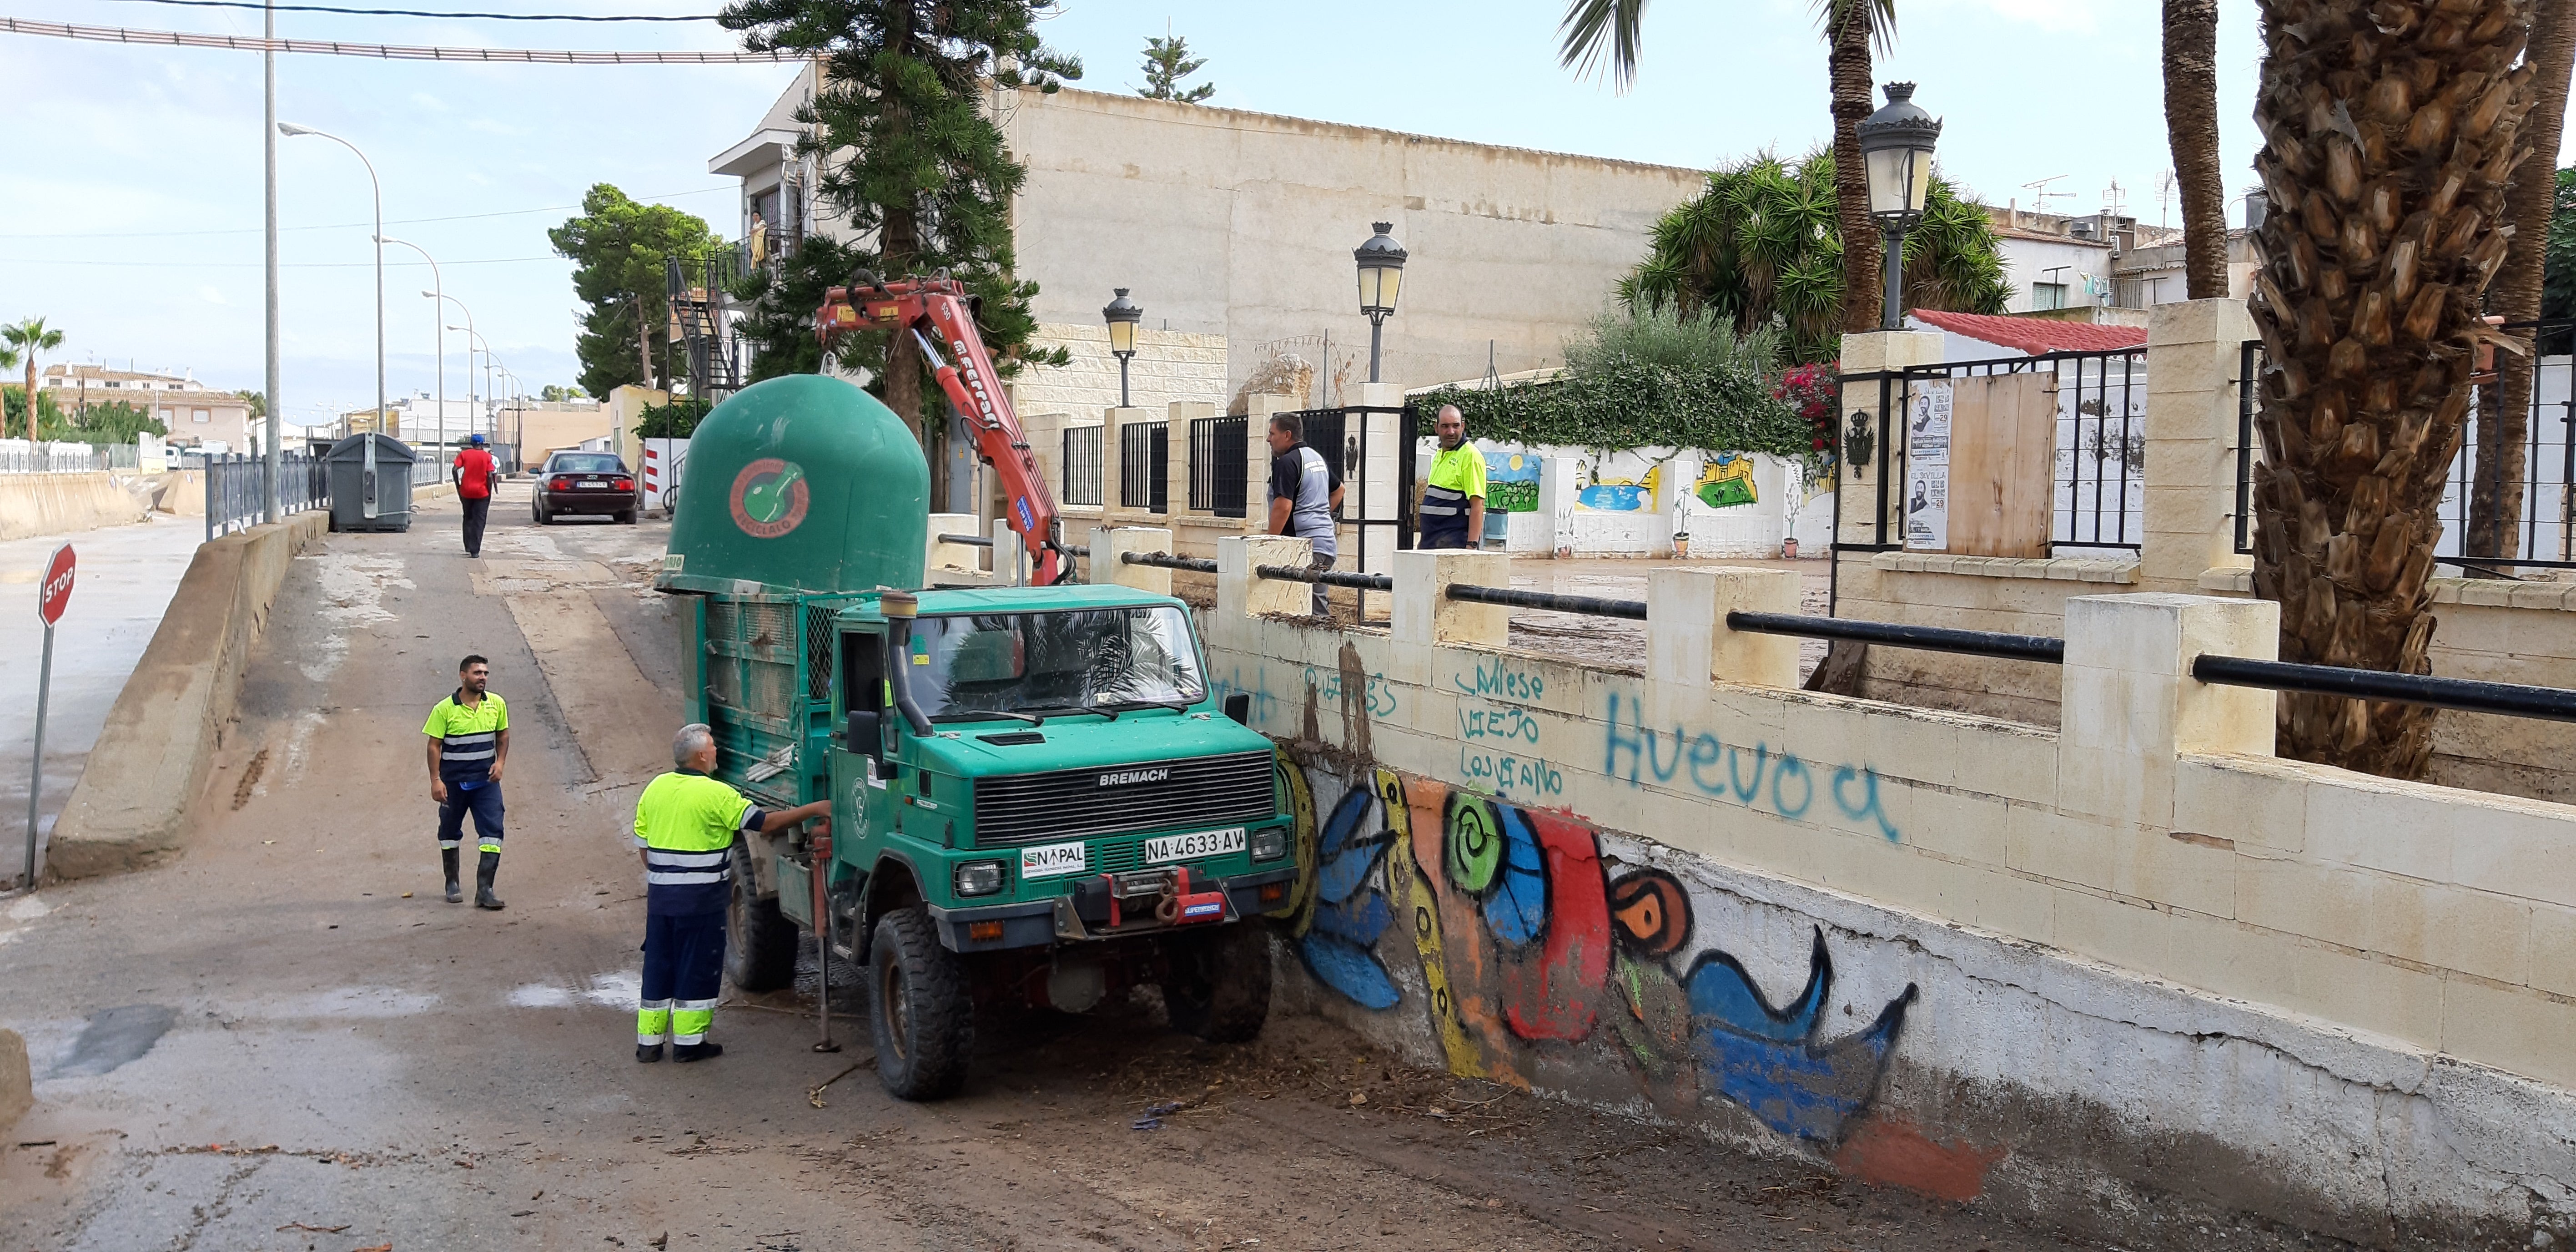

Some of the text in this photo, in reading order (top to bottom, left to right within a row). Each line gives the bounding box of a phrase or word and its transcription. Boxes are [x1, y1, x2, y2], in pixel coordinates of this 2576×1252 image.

[941, 302, 951, 320] 530
[45, 566, 74, 603] STOP
[1459, 708, 1539, 744] VIEJO
[1099, 769, 1168, 786] BREMACH
